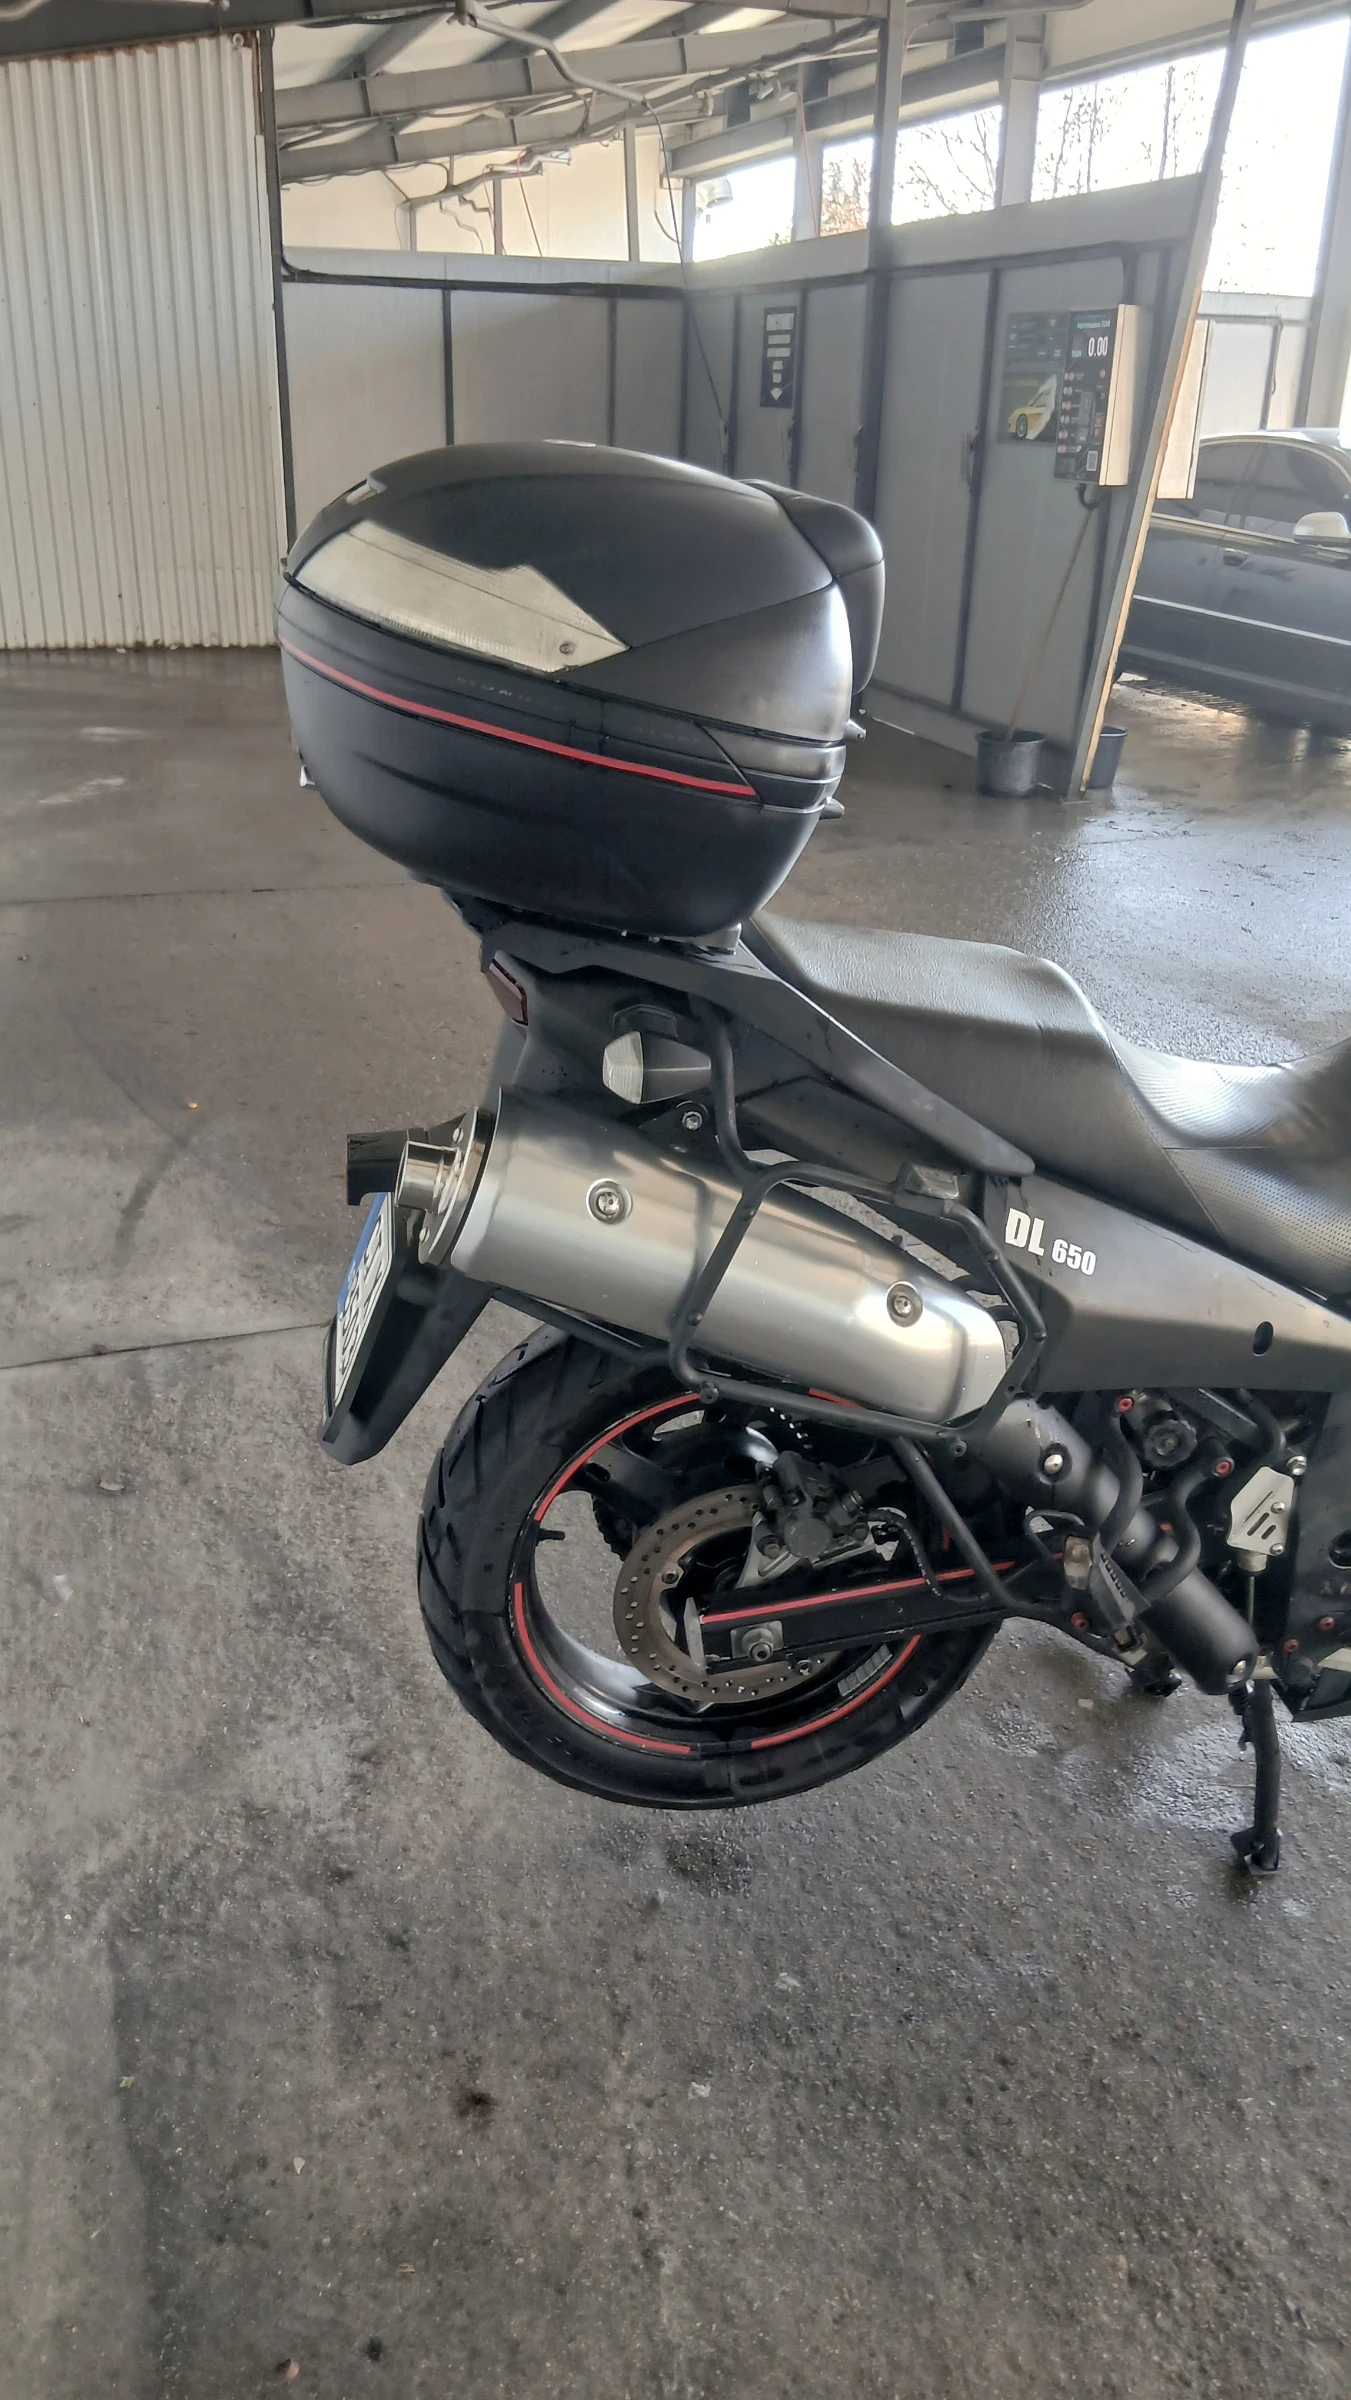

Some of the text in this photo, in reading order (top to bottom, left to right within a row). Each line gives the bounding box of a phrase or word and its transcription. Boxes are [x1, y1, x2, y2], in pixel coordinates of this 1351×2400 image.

[1088, 336, 1109, 357] 0.00
[1005, 1207, 1097, 1276] DL 650
